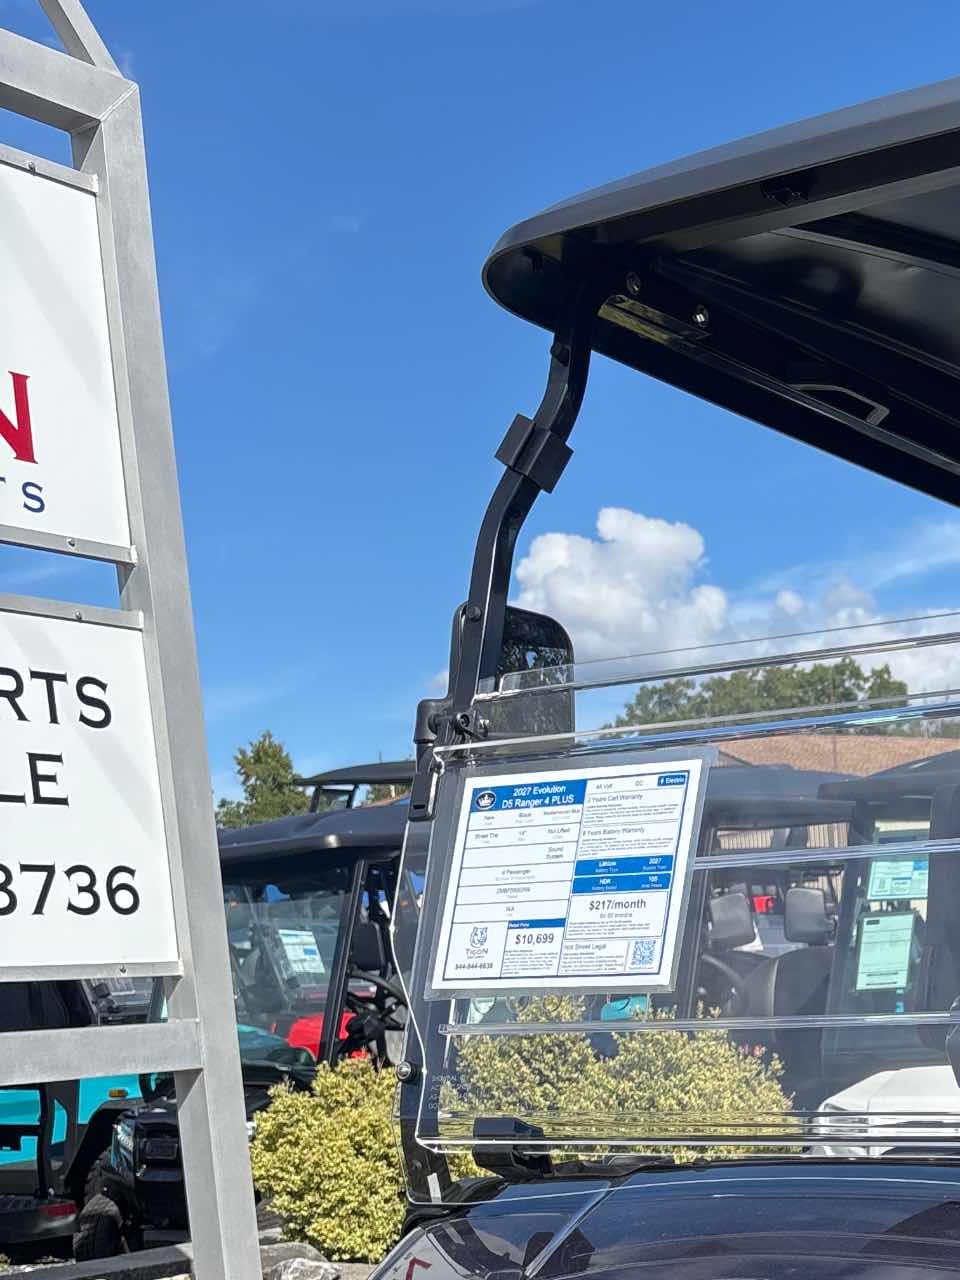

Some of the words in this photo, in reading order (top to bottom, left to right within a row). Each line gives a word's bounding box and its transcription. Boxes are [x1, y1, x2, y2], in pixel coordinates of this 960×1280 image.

[513, 788, 531, 796] 2027
[533, 785, 566, 795] Evolution
[502, 800, 513, 809] D5
[515, 798, 542, 809] Ranger
[552, 795, 574, 804] PLUS
[589, 899, 646, 911] $217/month
[515, 933, 554, 945] $10,699
